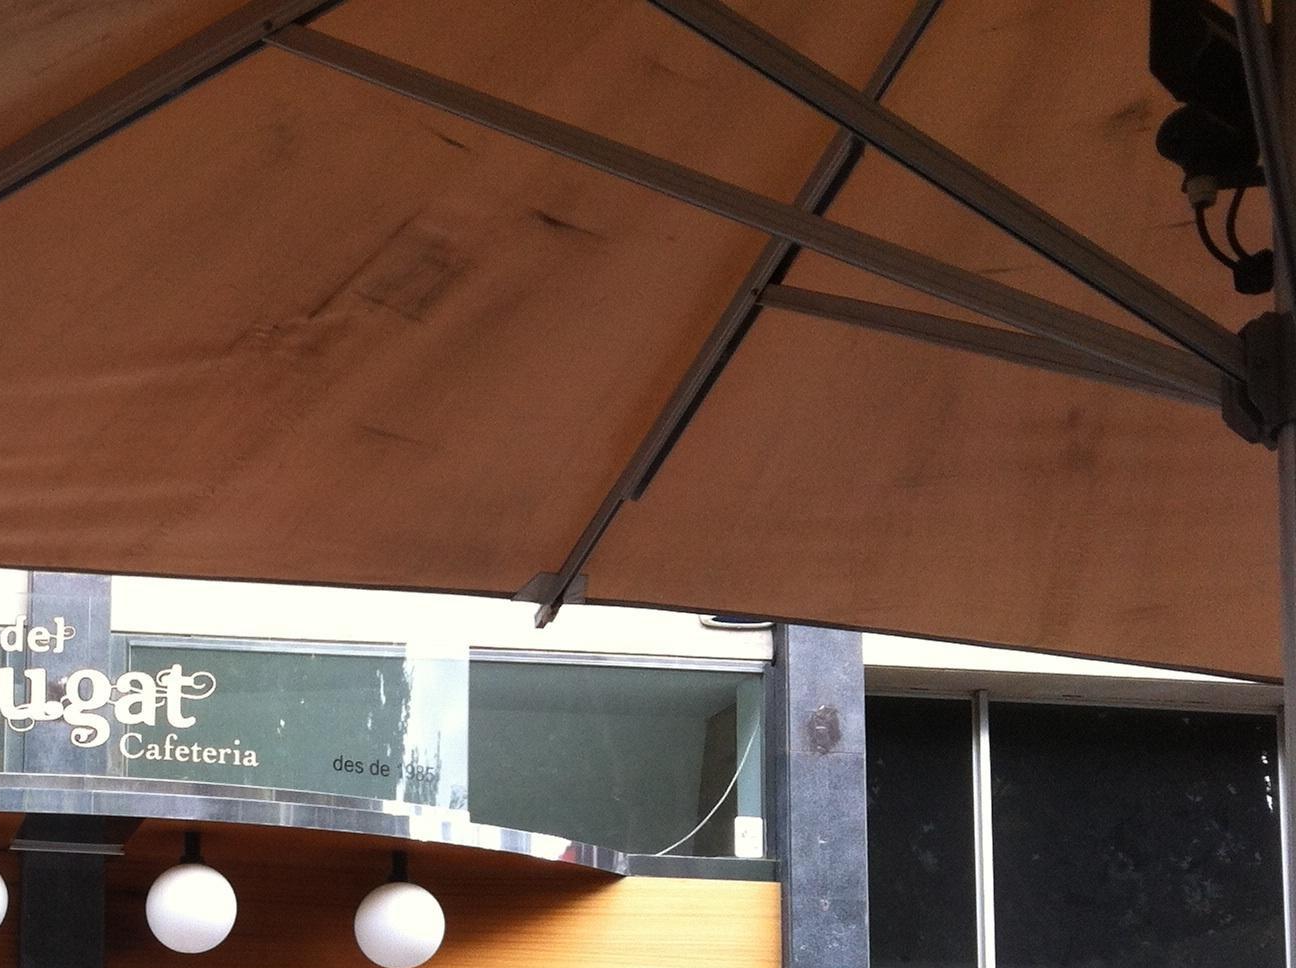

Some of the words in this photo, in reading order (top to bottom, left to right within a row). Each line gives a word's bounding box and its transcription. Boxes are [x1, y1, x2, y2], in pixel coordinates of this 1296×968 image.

[0, 615, 76, 654] del
[119, 732, 260, 768] Cafeteria
[332, 754, 365, 775] des
[369, 759, 391, 778] de
